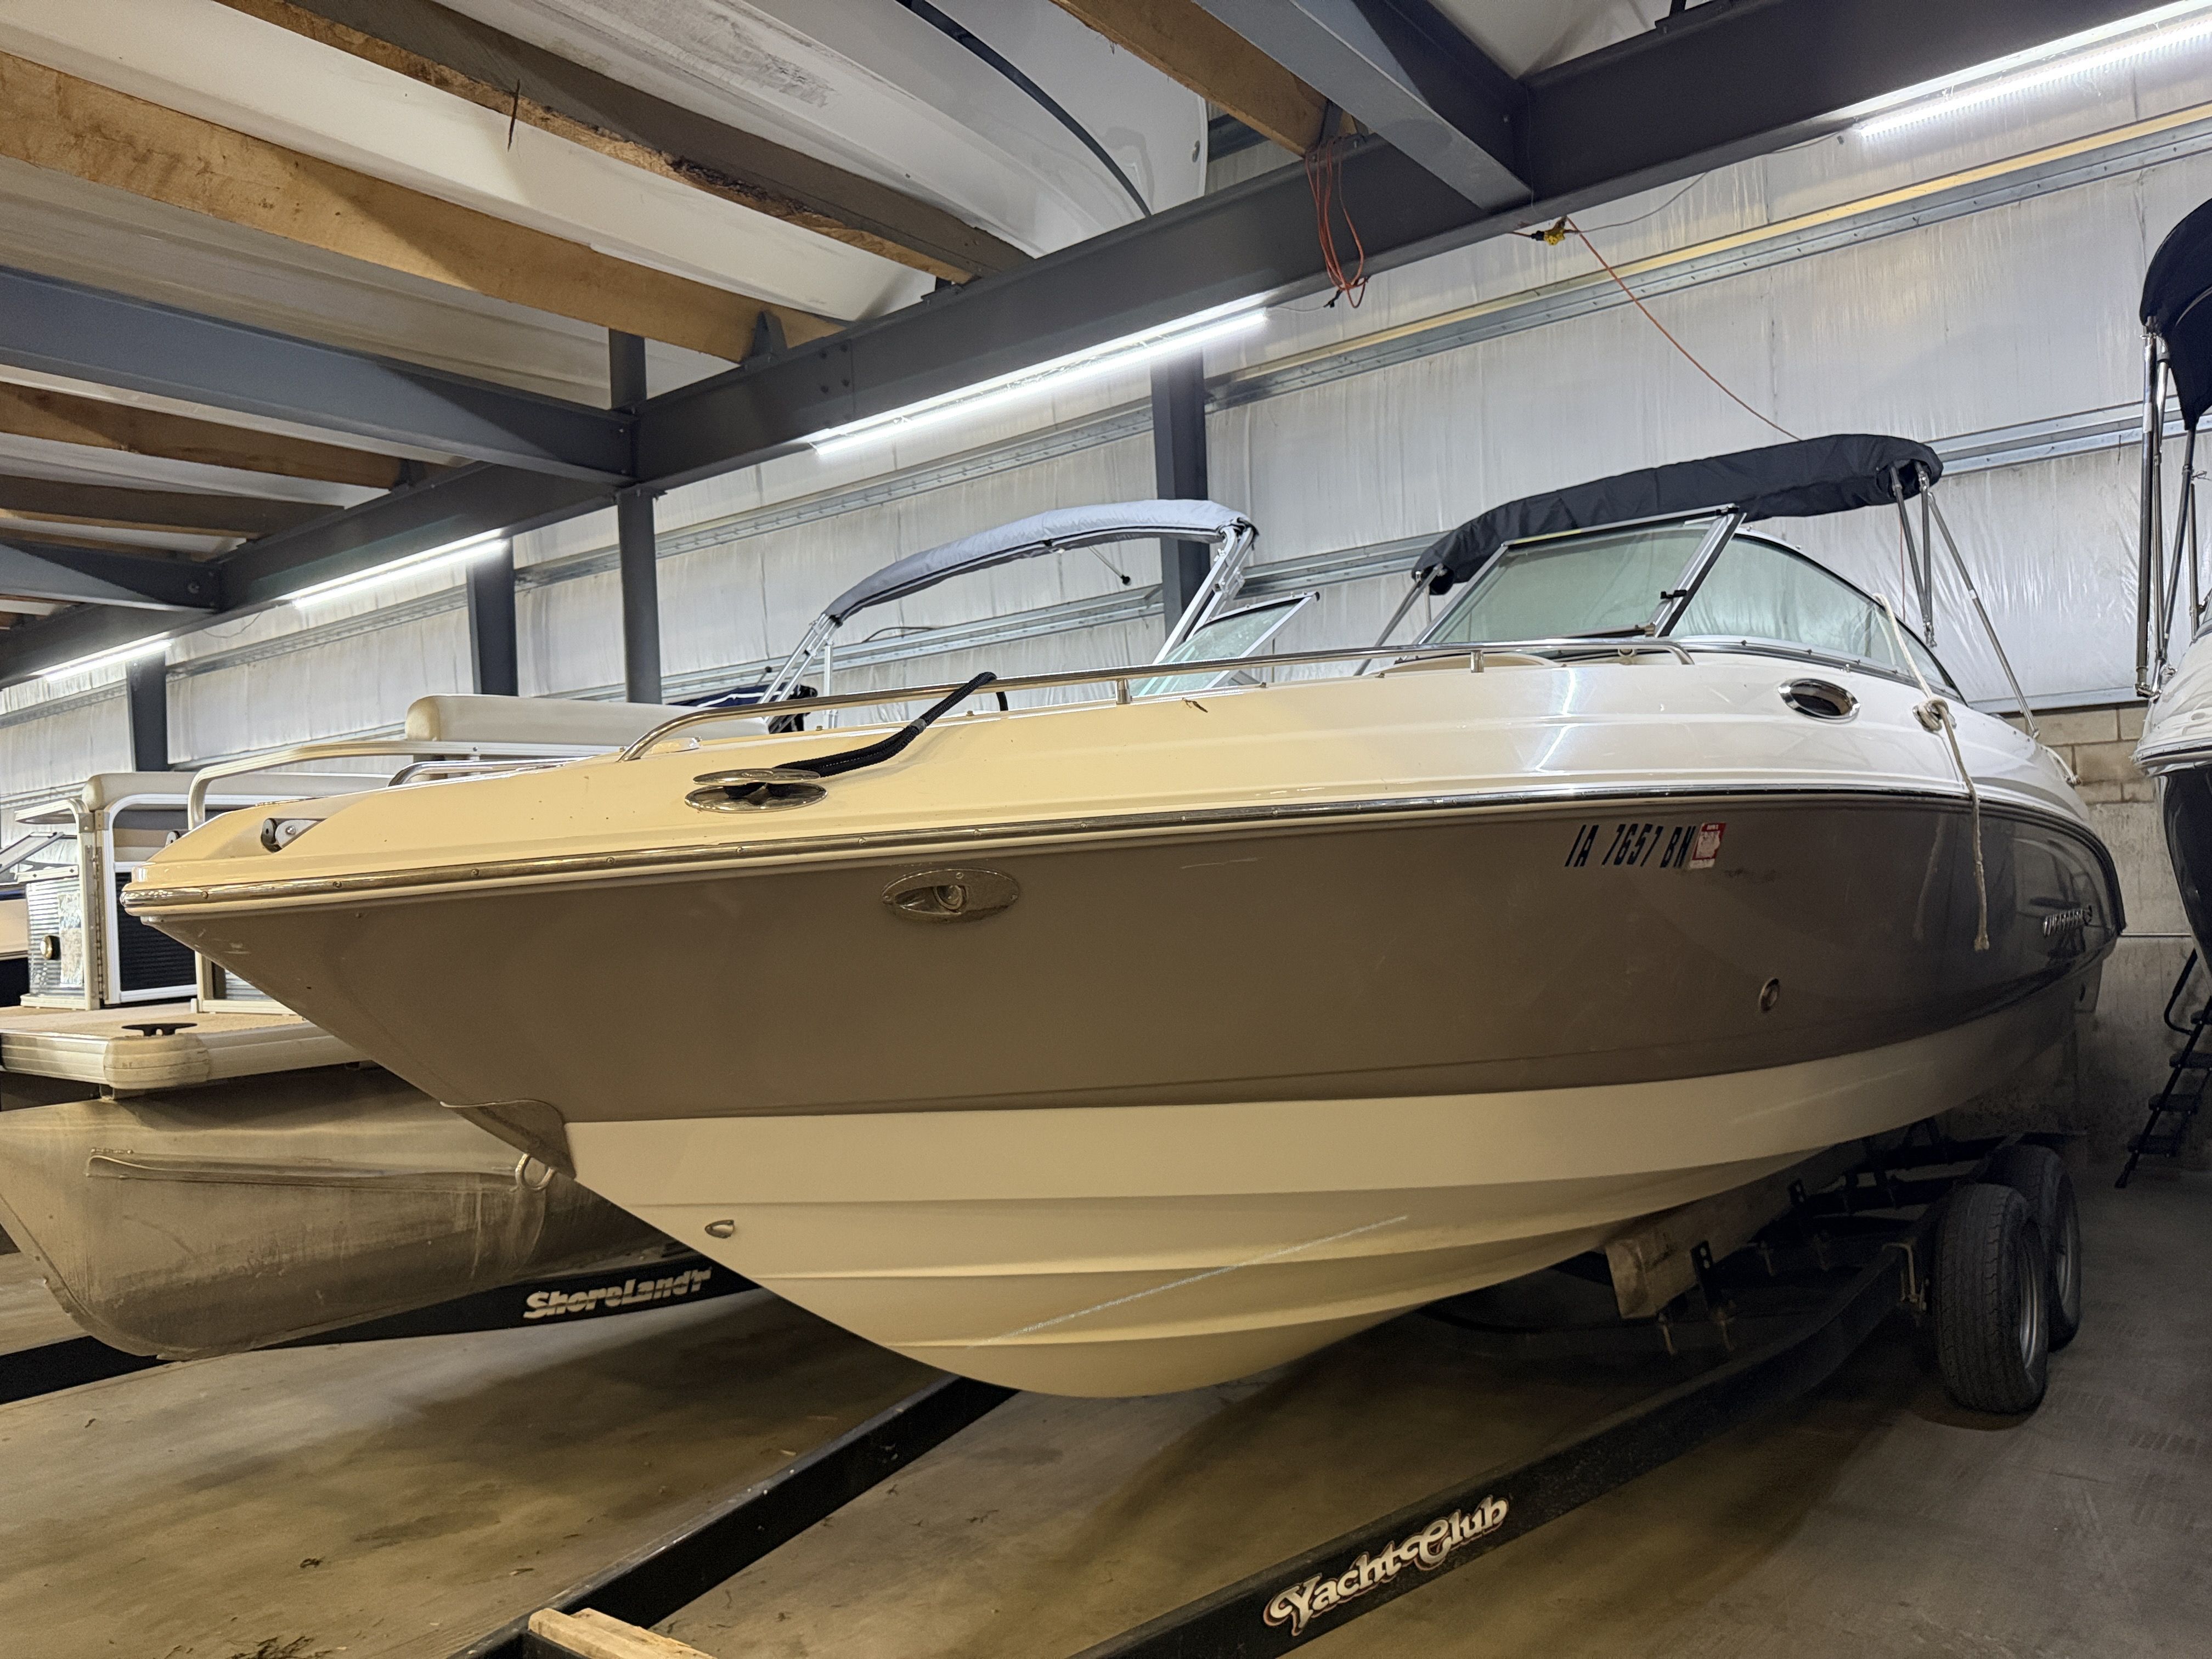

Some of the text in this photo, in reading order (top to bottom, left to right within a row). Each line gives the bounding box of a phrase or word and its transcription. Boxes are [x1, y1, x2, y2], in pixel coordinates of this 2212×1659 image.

[1565, 823, 1696, 868] IA 7657 BN
